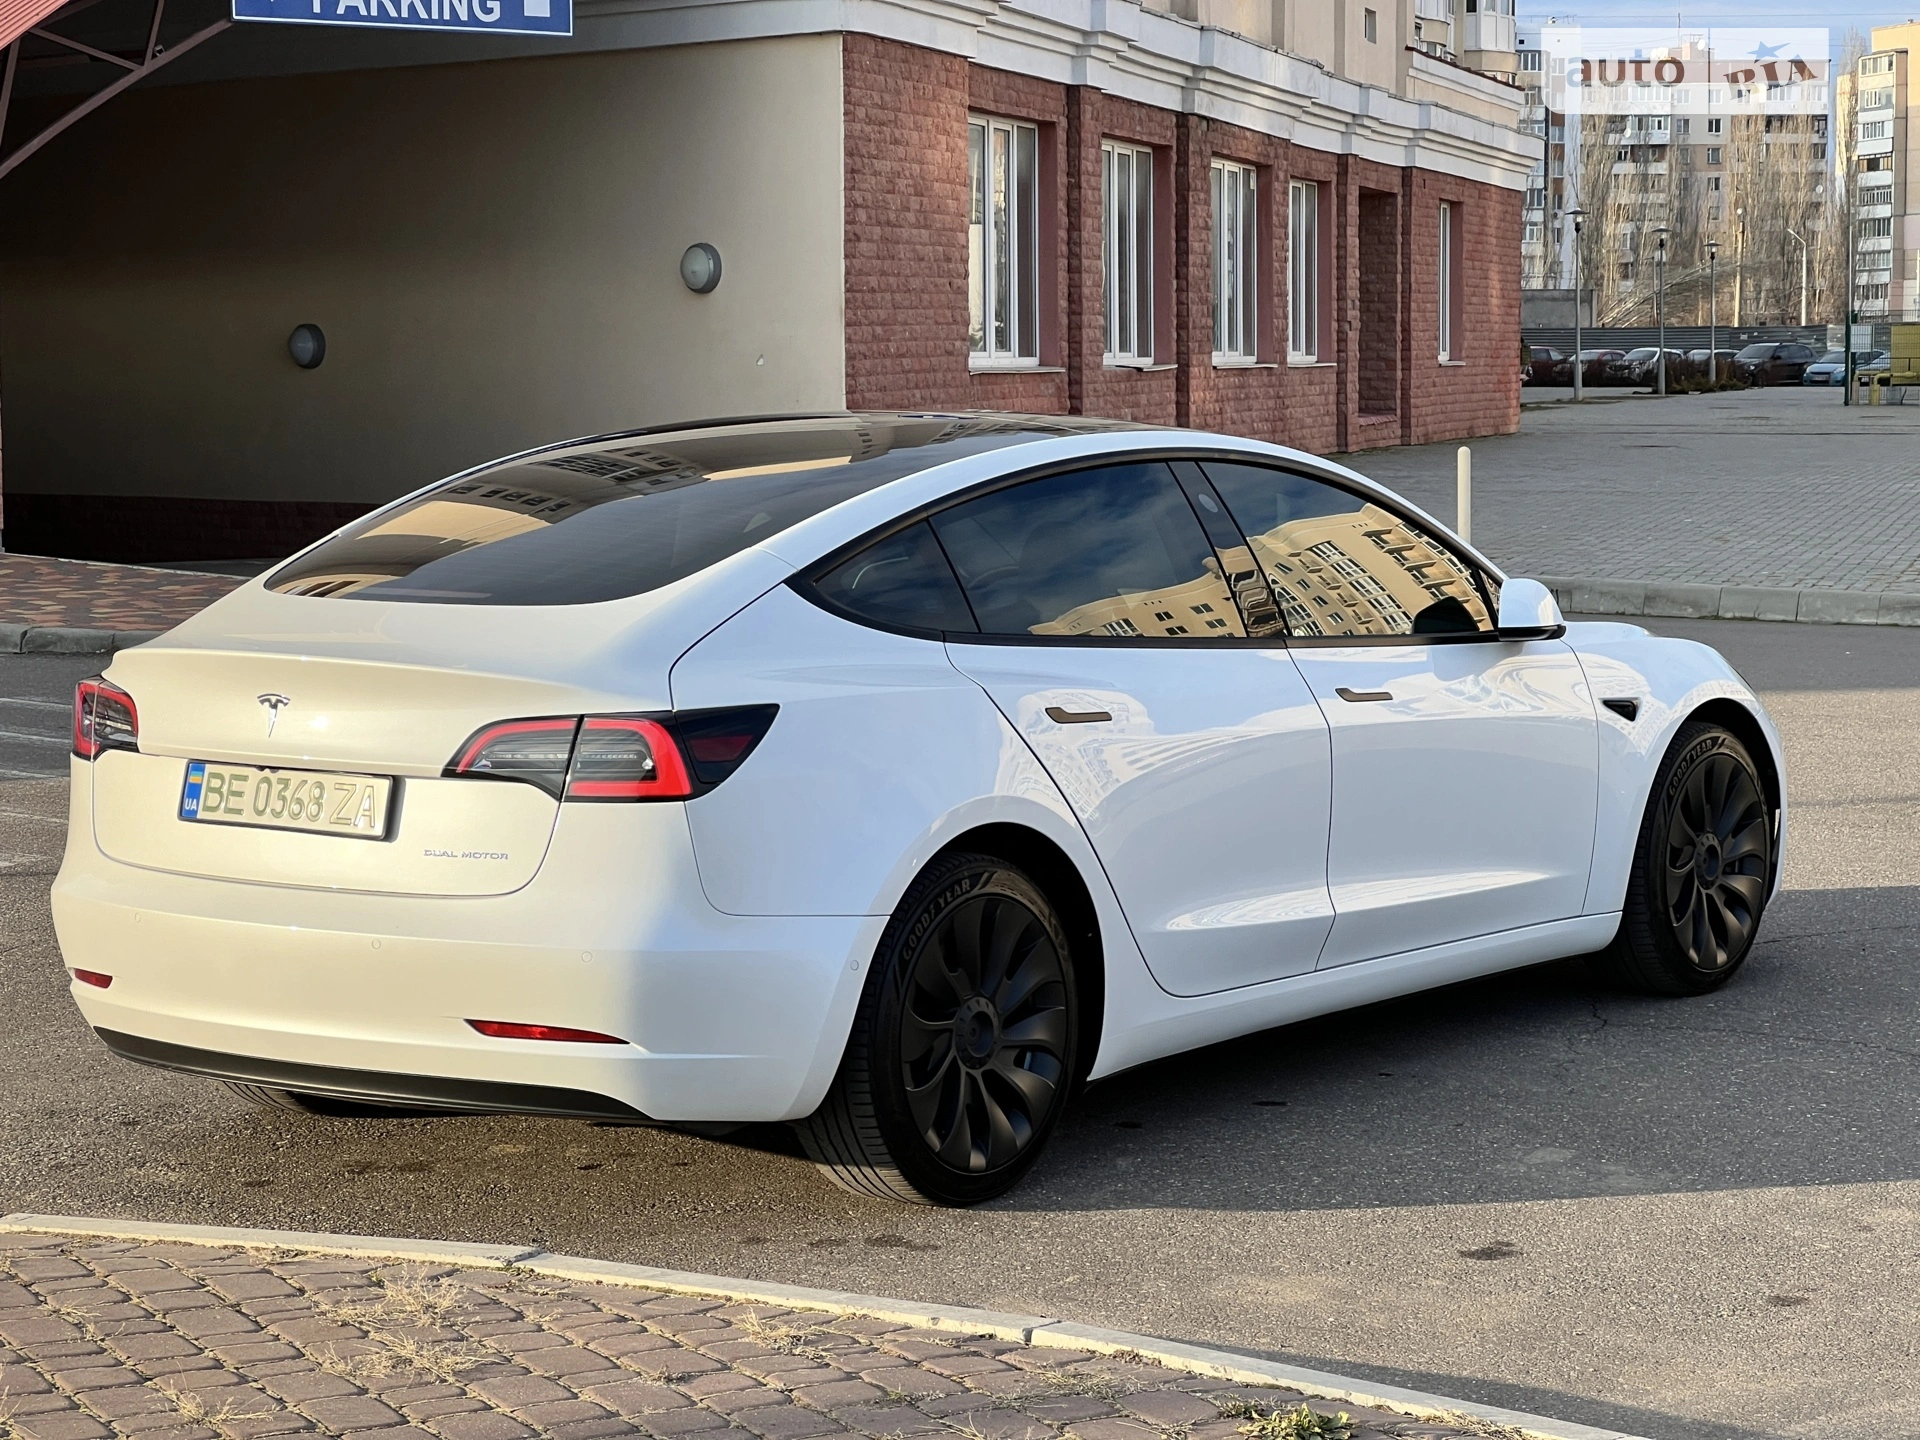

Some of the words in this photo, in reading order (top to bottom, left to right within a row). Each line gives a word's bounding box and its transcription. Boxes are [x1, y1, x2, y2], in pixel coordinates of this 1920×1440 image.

[1669, 739, 1713, 796] GOODYEAR
[184, 797, 198, 812] UA
[201, 771, 250, 816] BE
[252, 776, 327, 823] 0368
[329, 782, 377, 829] ZA
[423, 848, 459, 859] DUAL
[461, 850, 509, 861] MOTOR
[902, 877, 972, 961] GOODYEAR
